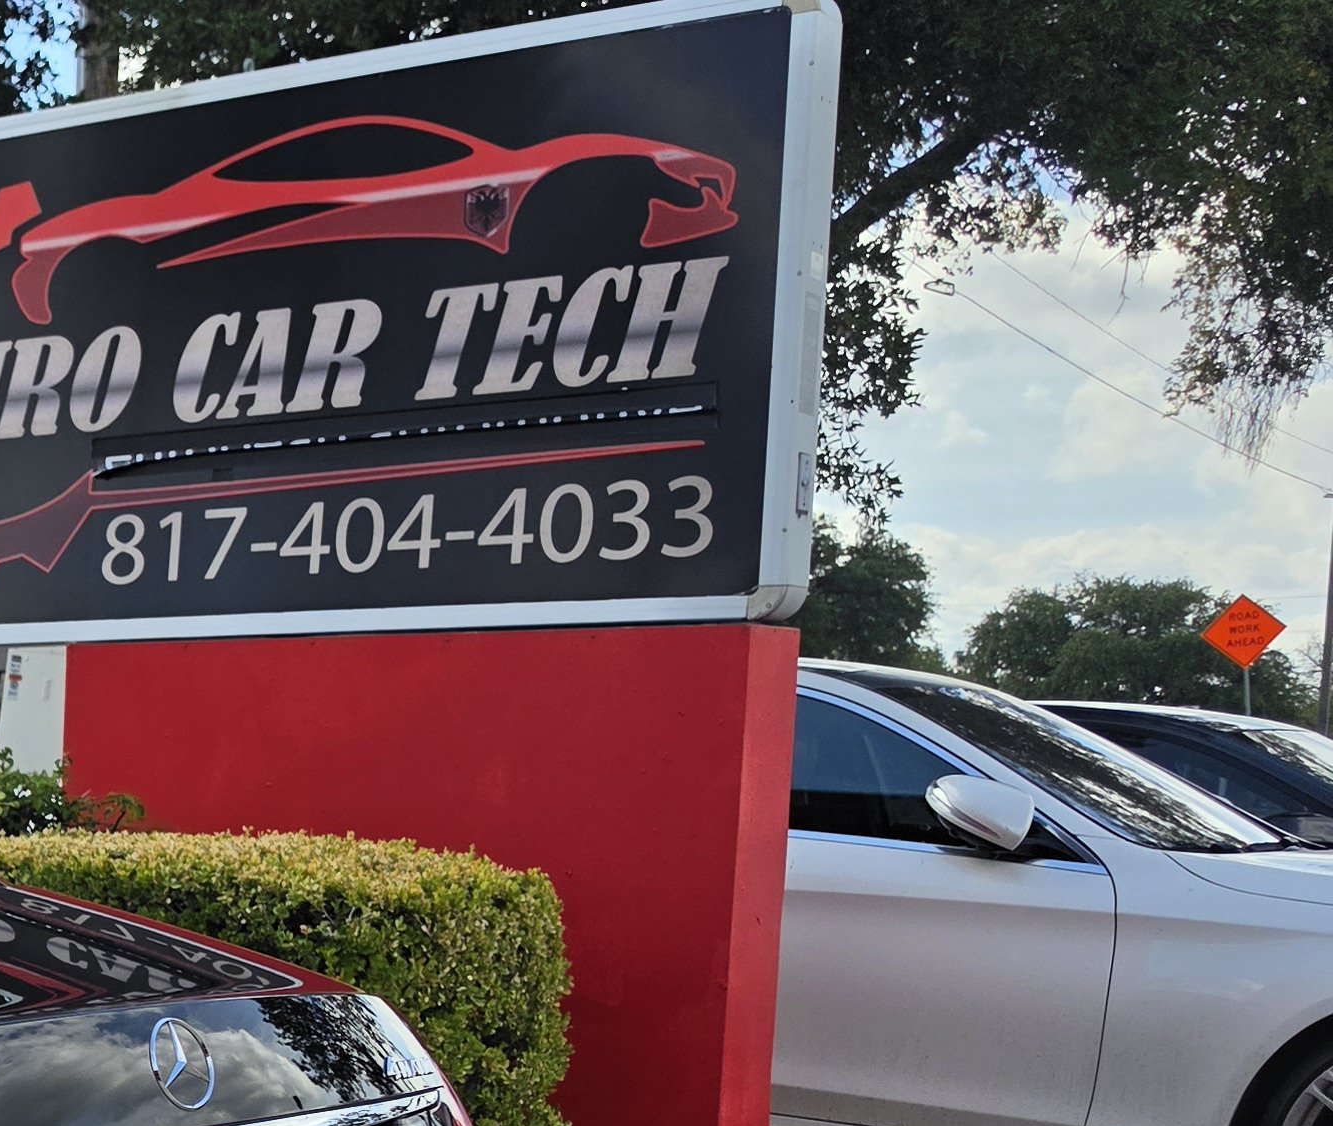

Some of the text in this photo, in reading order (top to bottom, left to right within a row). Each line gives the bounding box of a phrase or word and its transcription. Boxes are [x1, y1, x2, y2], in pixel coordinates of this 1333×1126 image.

[173, 298, 382, 424] CAR
[414, 256, 728, 401] TECH
[101, 475, 715, 587] 817-404-4033
[1229, 611, 1259, 621] ROAD
[1229, 624, 1261, 634] WORK
[1227, 636, 1265, 648] AHEAD
